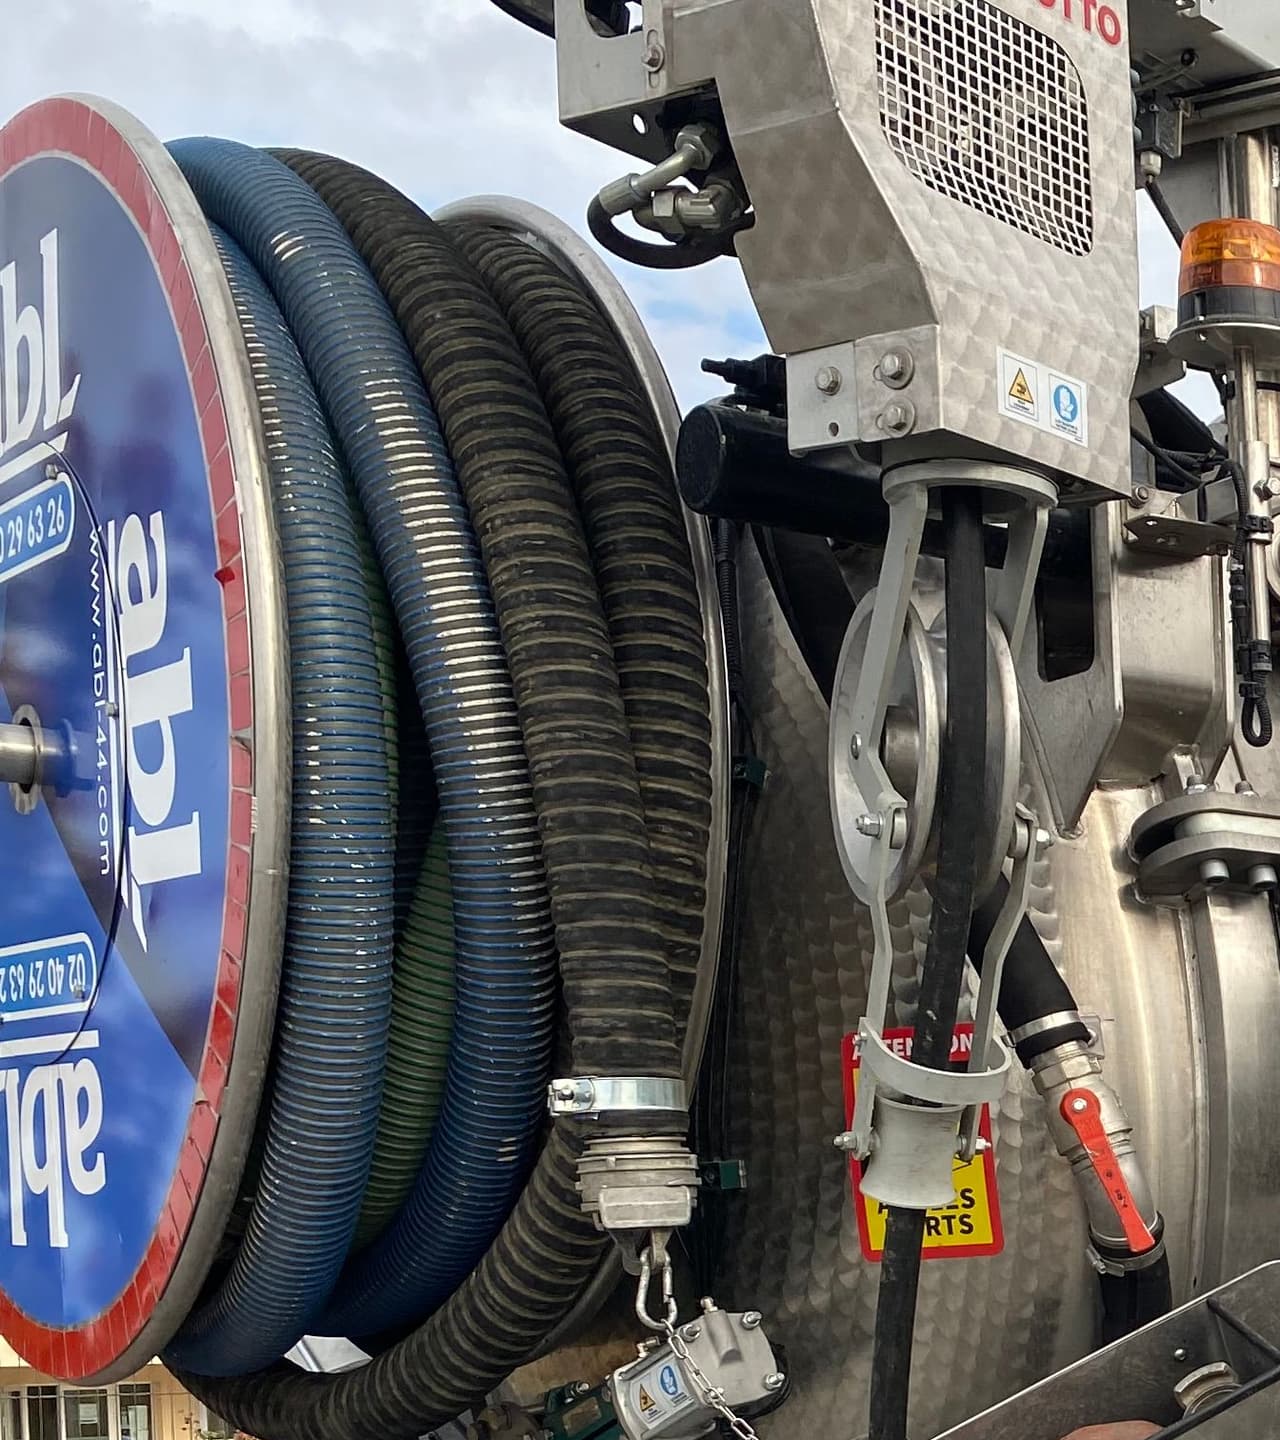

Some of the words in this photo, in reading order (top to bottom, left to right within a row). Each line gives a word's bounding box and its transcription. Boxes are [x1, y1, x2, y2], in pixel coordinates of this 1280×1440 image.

[8, 516, 24, 558] 29
[28, 505, 44, 551] 63
[48, 494, 65, 538] 26
[89, 526, 111, 876] www.abl-44.com
[117, 510, 202, 952] abl
[9, 963, 25, 1003] 63
[29, 960, 45, 999] 29
[48, 956, 65, 996] 40
[924, 1213, 975, 1237] RTS
